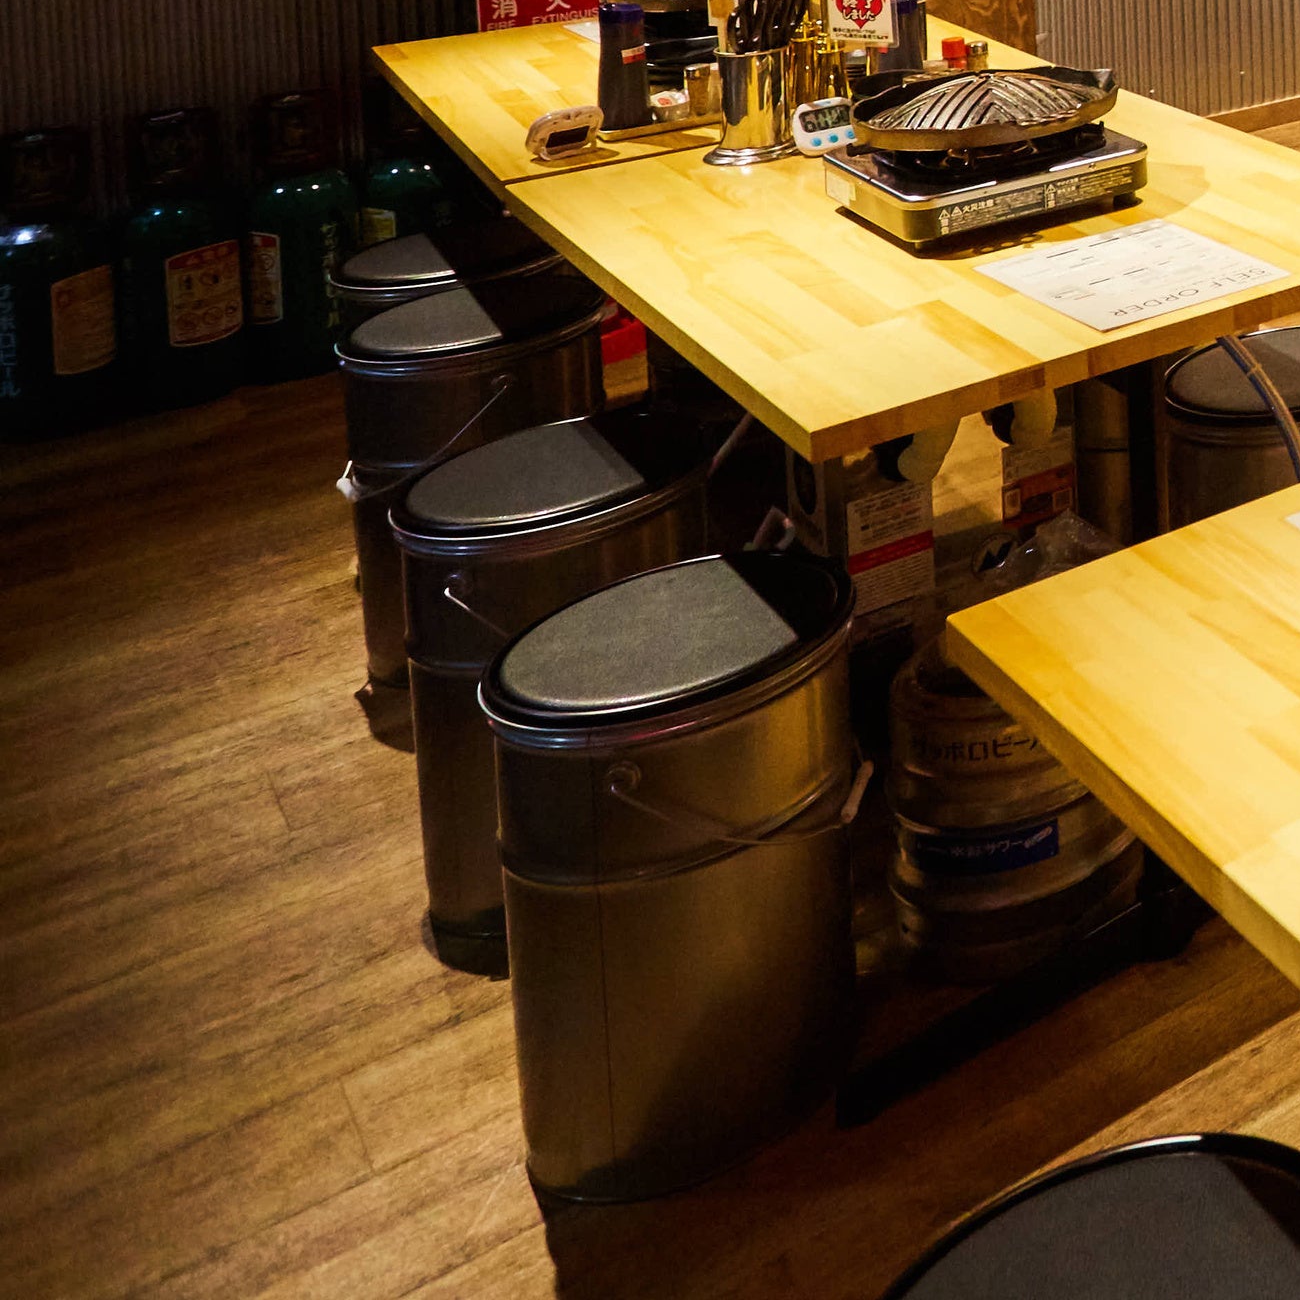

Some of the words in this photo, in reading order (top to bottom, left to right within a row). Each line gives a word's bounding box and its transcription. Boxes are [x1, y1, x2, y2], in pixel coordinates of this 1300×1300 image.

[842, 8, 876, 21] しました
[1111, 288, 1200, 319] ORDER
